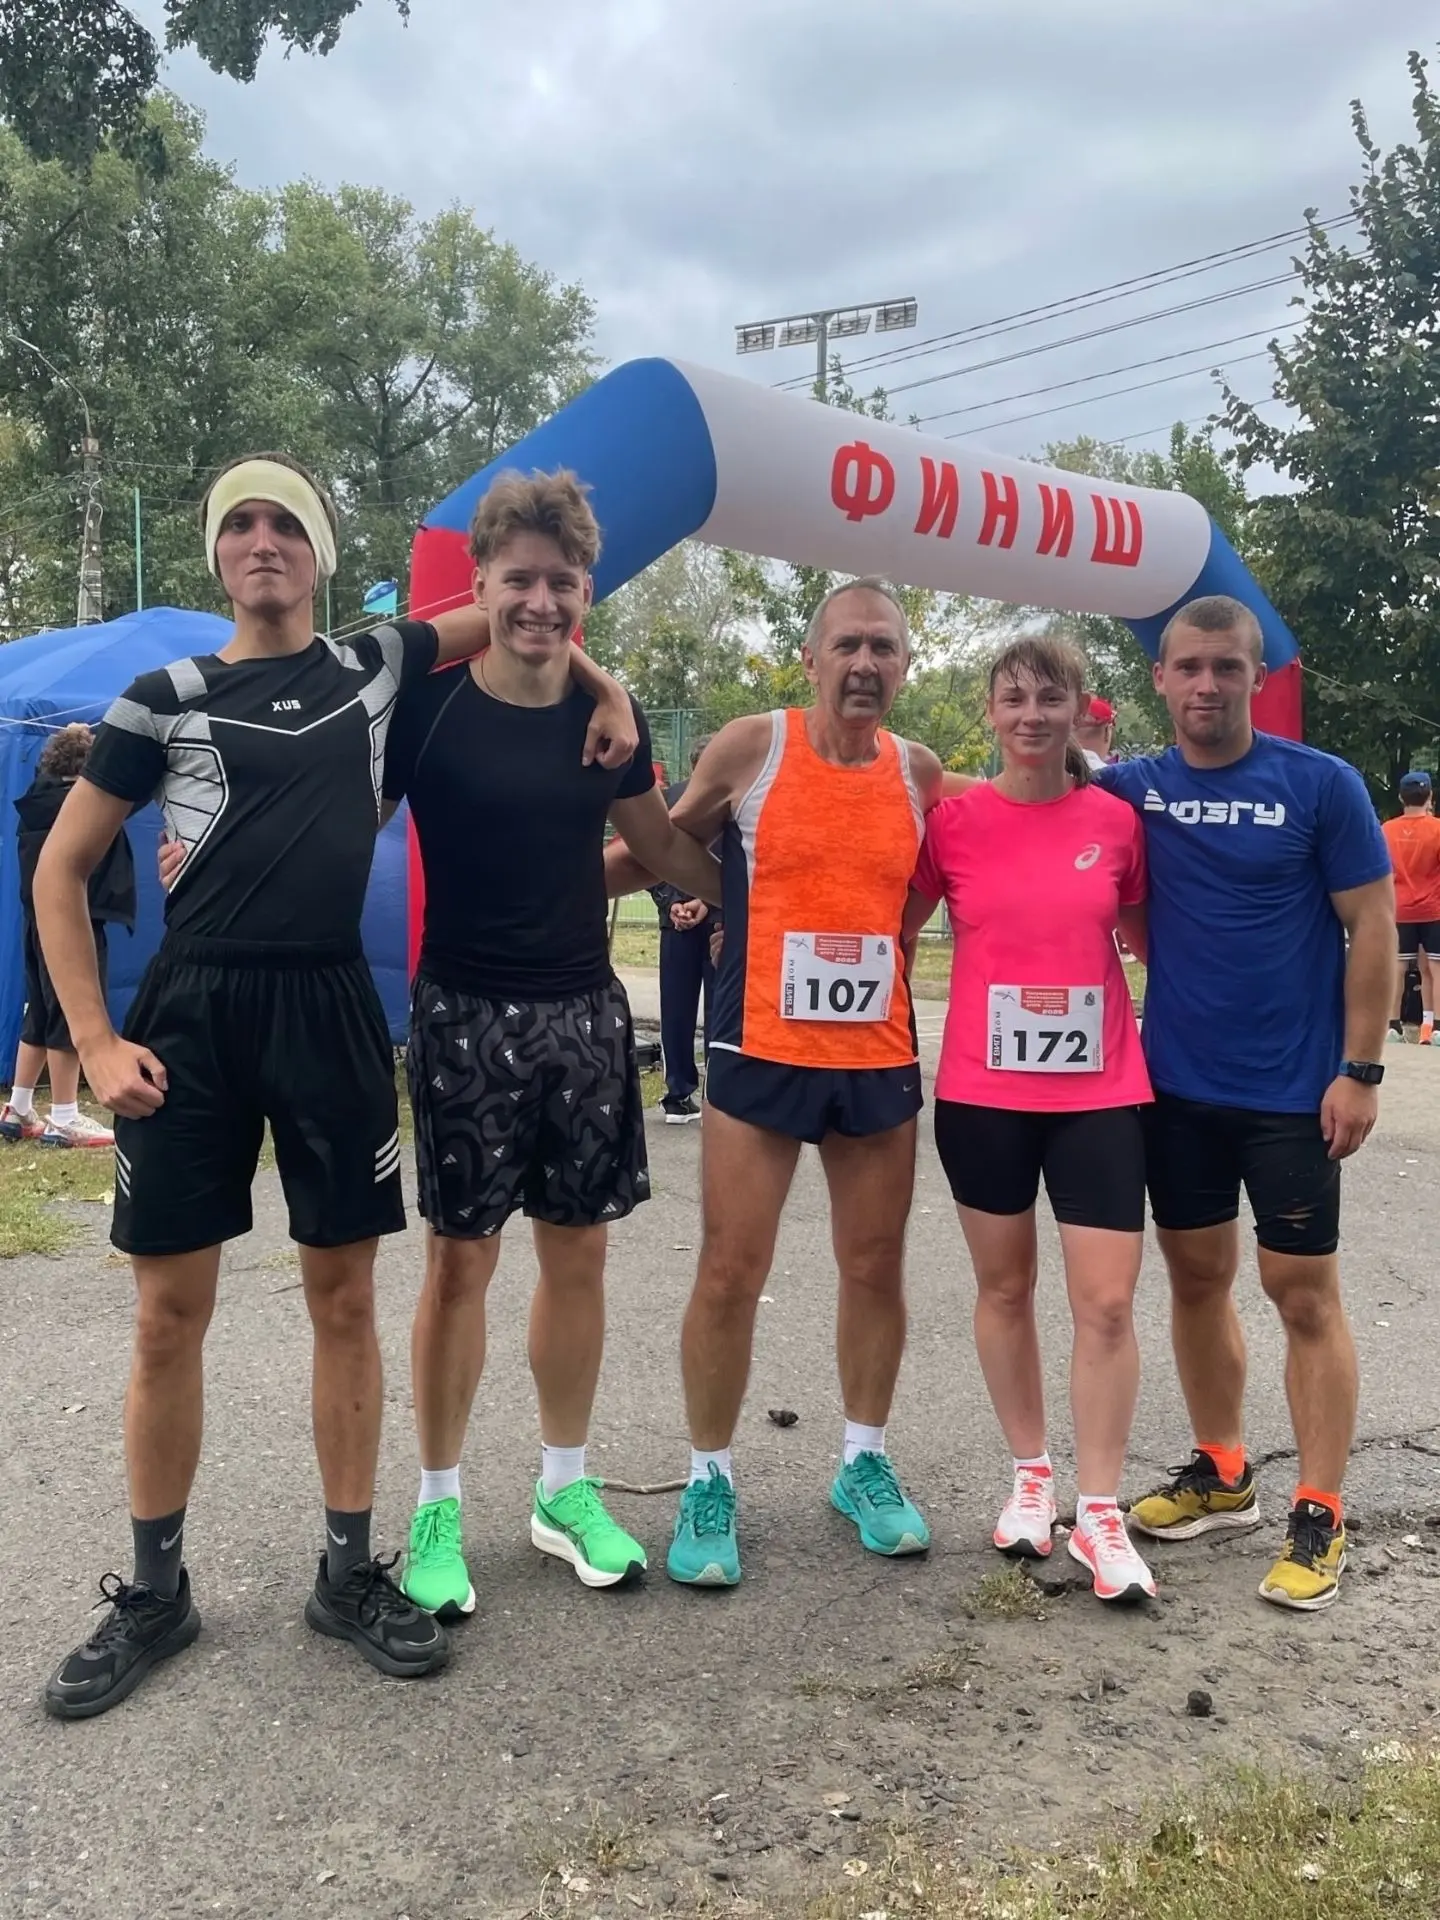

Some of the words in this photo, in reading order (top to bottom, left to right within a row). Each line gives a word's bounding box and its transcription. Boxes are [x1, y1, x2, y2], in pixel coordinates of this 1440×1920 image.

[831, 440, 1143, 567] ФИНИШ
[271, 700, 301, 712] XUS
[806, 978, 880, 1013] 107
[1013, 1030, 1088, 1063] 172
